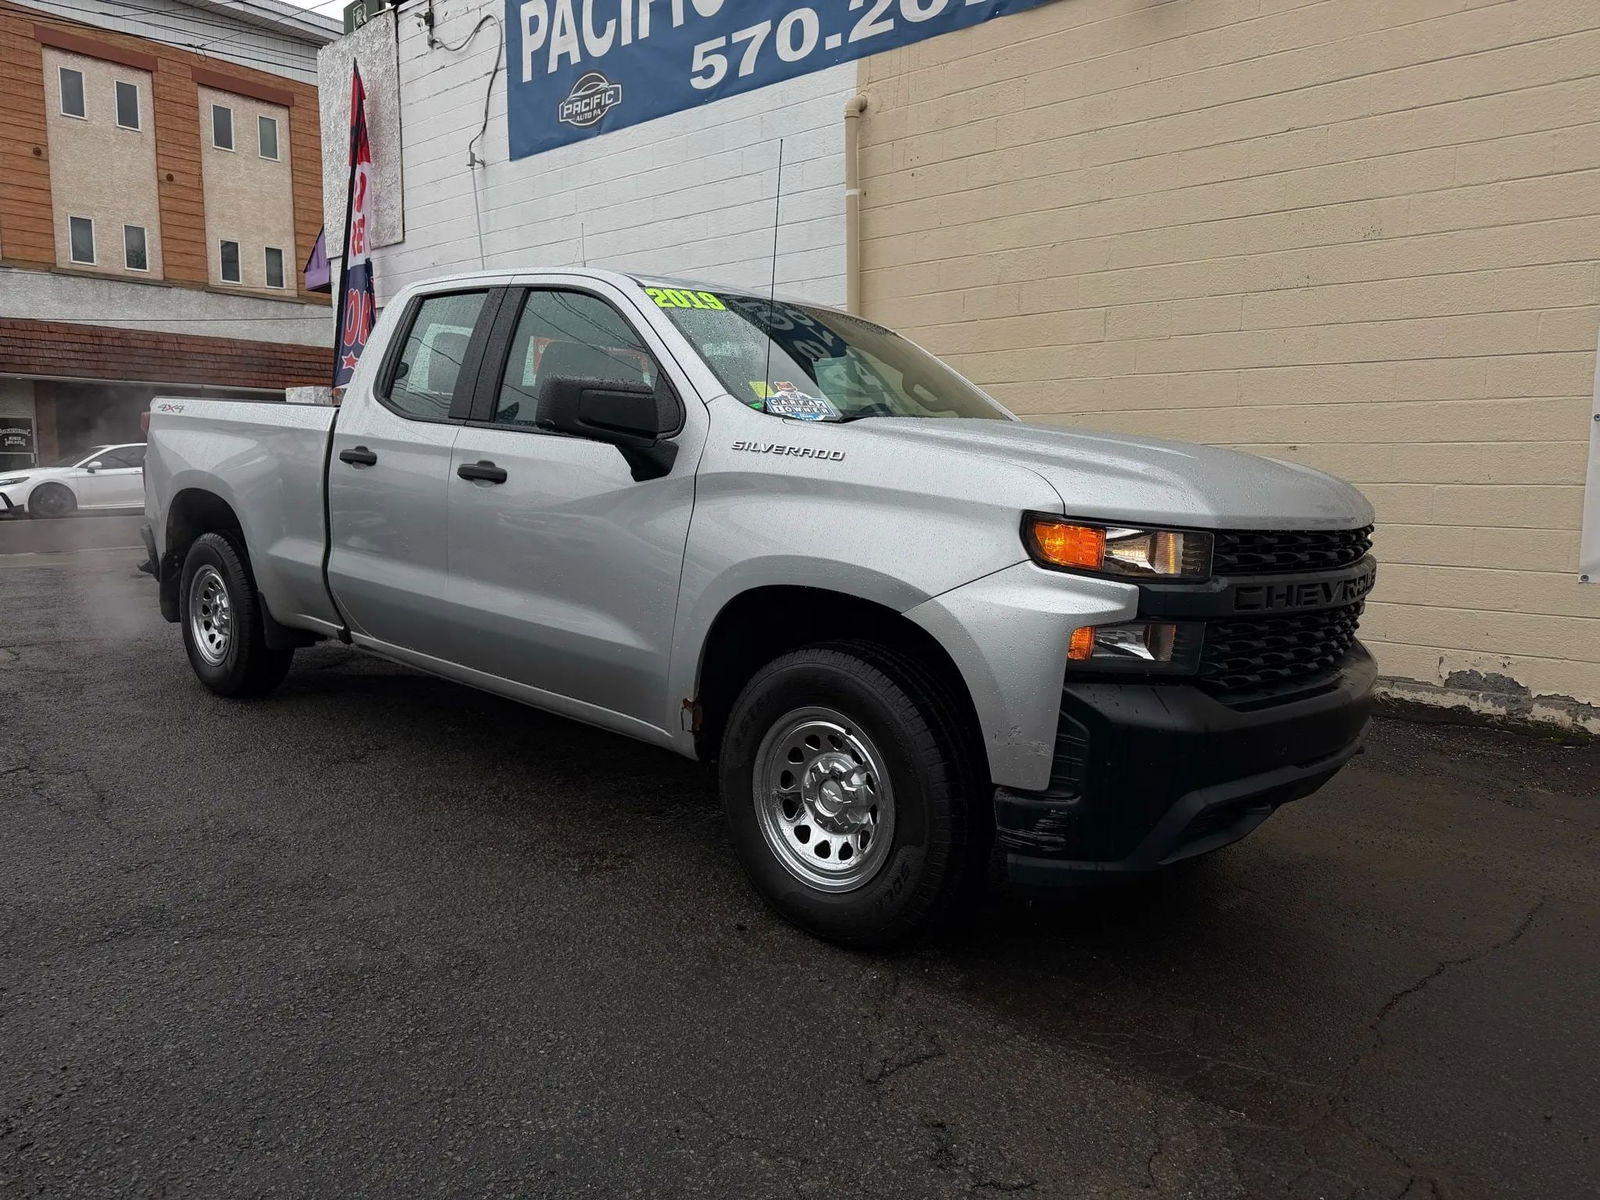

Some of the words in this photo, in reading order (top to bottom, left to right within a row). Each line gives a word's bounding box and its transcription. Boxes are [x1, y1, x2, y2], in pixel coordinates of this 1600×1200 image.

[520, 0, 724, 83] PACIF
[689, 0, 988, 90] 570.2
[563, 90, 614, 118] PACIFIC
[576, 111, 593, 122] AUTO
[644, 288, 727, 311] 2019
[770, 399, 827, 408] CARFAX
[784, 405, 829, 414] OWNER
[731, 440, 846, 461] SILVERADO
